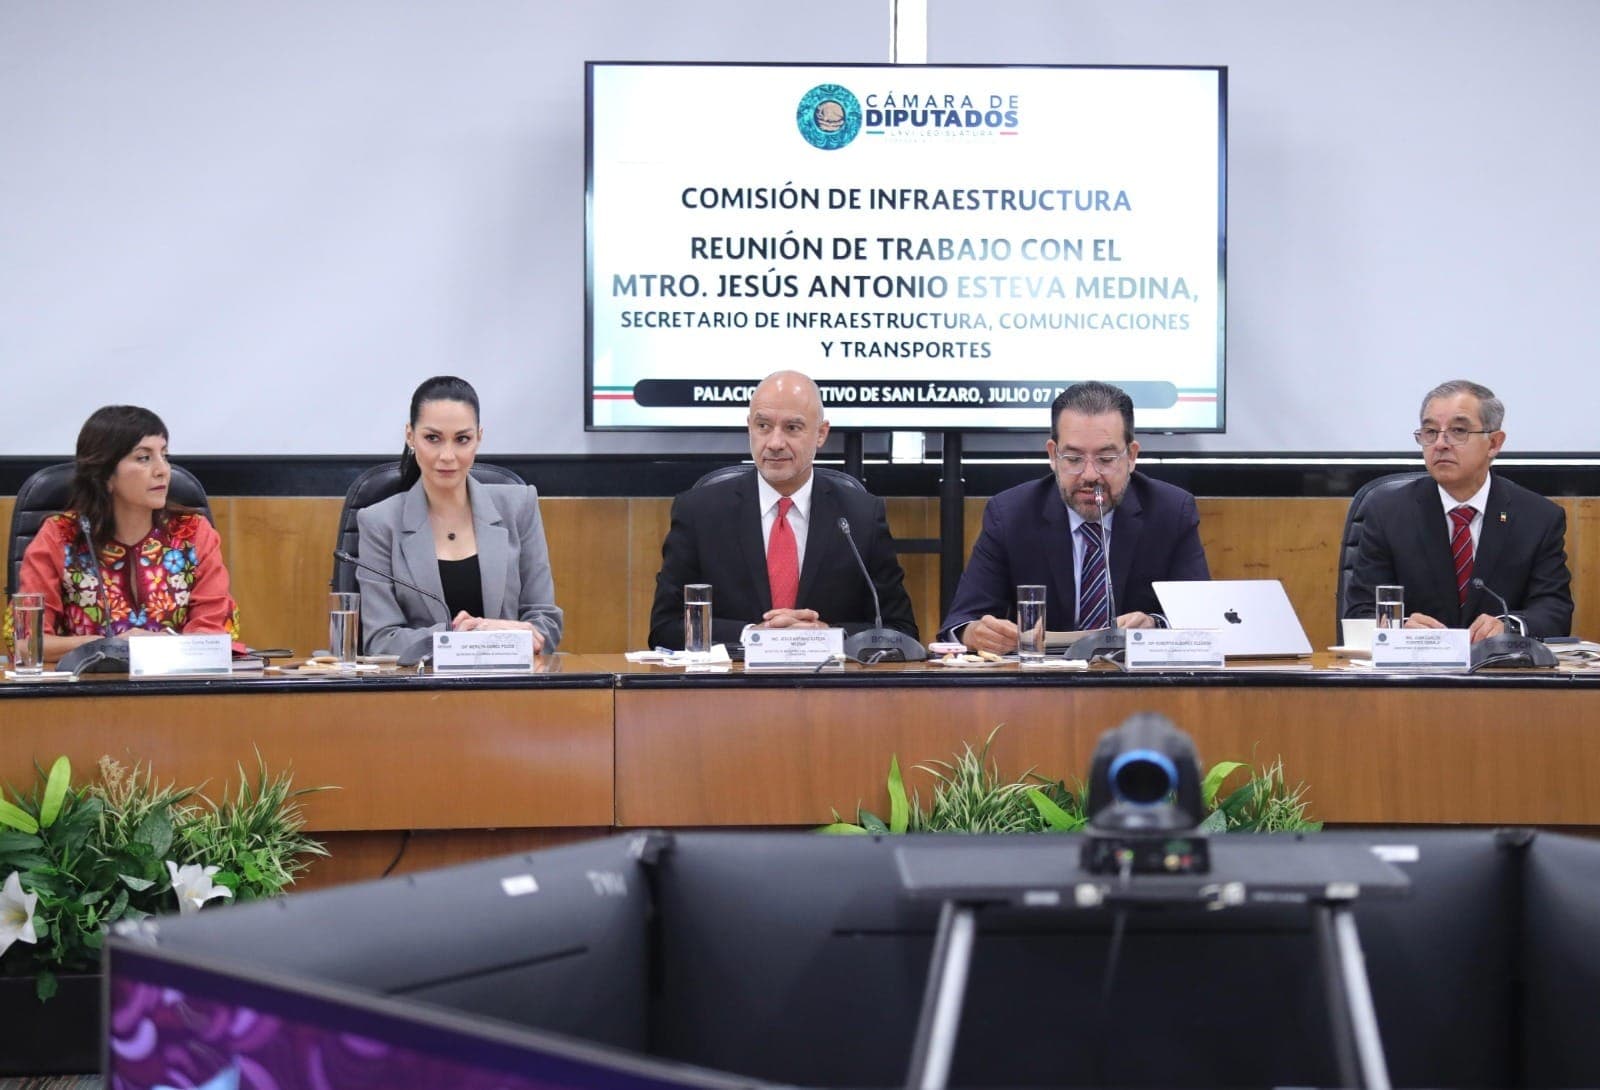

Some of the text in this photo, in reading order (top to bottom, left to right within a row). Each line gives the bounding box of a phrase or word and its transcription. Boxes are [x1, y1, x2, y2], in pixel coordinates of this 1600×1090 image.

[865, 90, 1019, 110] CÁMARA DE
[865, 109, 1019, 128] DIPUTADOS
[681, 181, 1133, 212] COMISIÓN DE INFRAESTRUCTURA
[690, 230, 1122, 262] REUNIÓN DE TRABAJO CON EL
[611, 267, 1199, 303] MTRO. JESÚS ANTONIO ESTEVA MEDINA,
[620, 311, 1191, 332] SECRETARIO DE INFRAESTRUCTURA, COMUNICACIONES
[820, 340, 992, 359] Y TRANSPORTES
[860, 386, 880, 402] DE
[882, 386, 914, 402] SAN
[916, 382, 984, 405] LÁZARO,
[988, 387, 1031, 403] JULIO
[1032, 387, 1052, 403] 07
